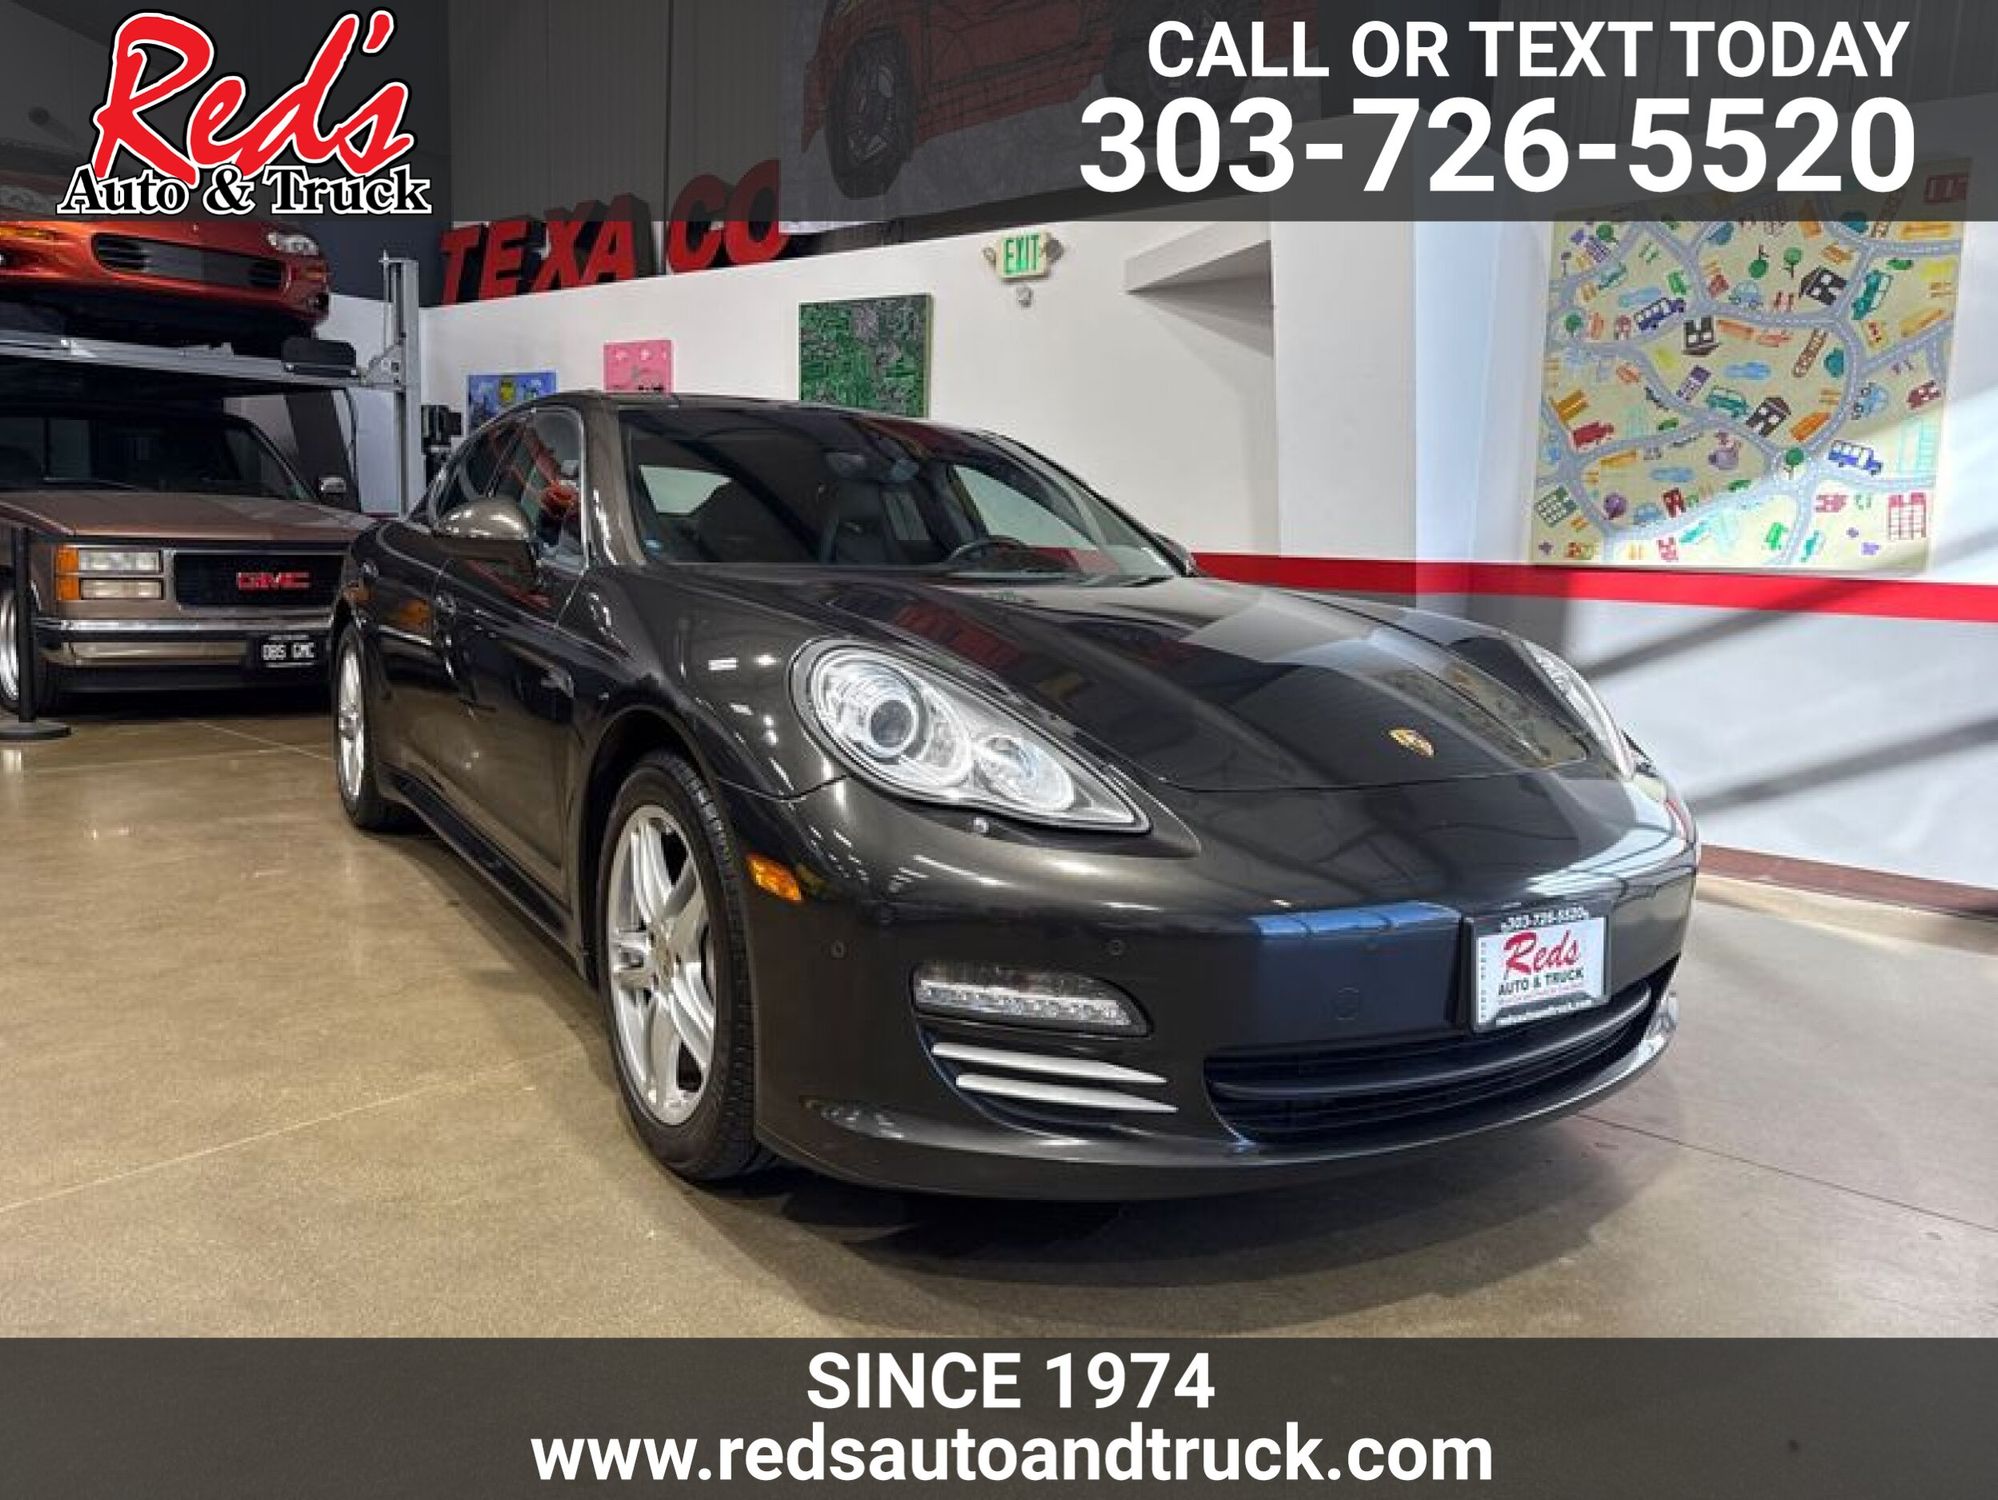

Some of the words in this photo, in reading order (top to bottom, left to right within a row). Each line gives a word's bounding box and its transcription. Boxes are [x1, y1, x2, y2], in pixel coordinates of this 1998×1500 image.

[1004, 234, 1041, 273] EXIT
[236, 571, 310, 590] GMC
[1499, 976, 1530, 996] AUTO
[1545, 966, 1584, 986] TRUCK
